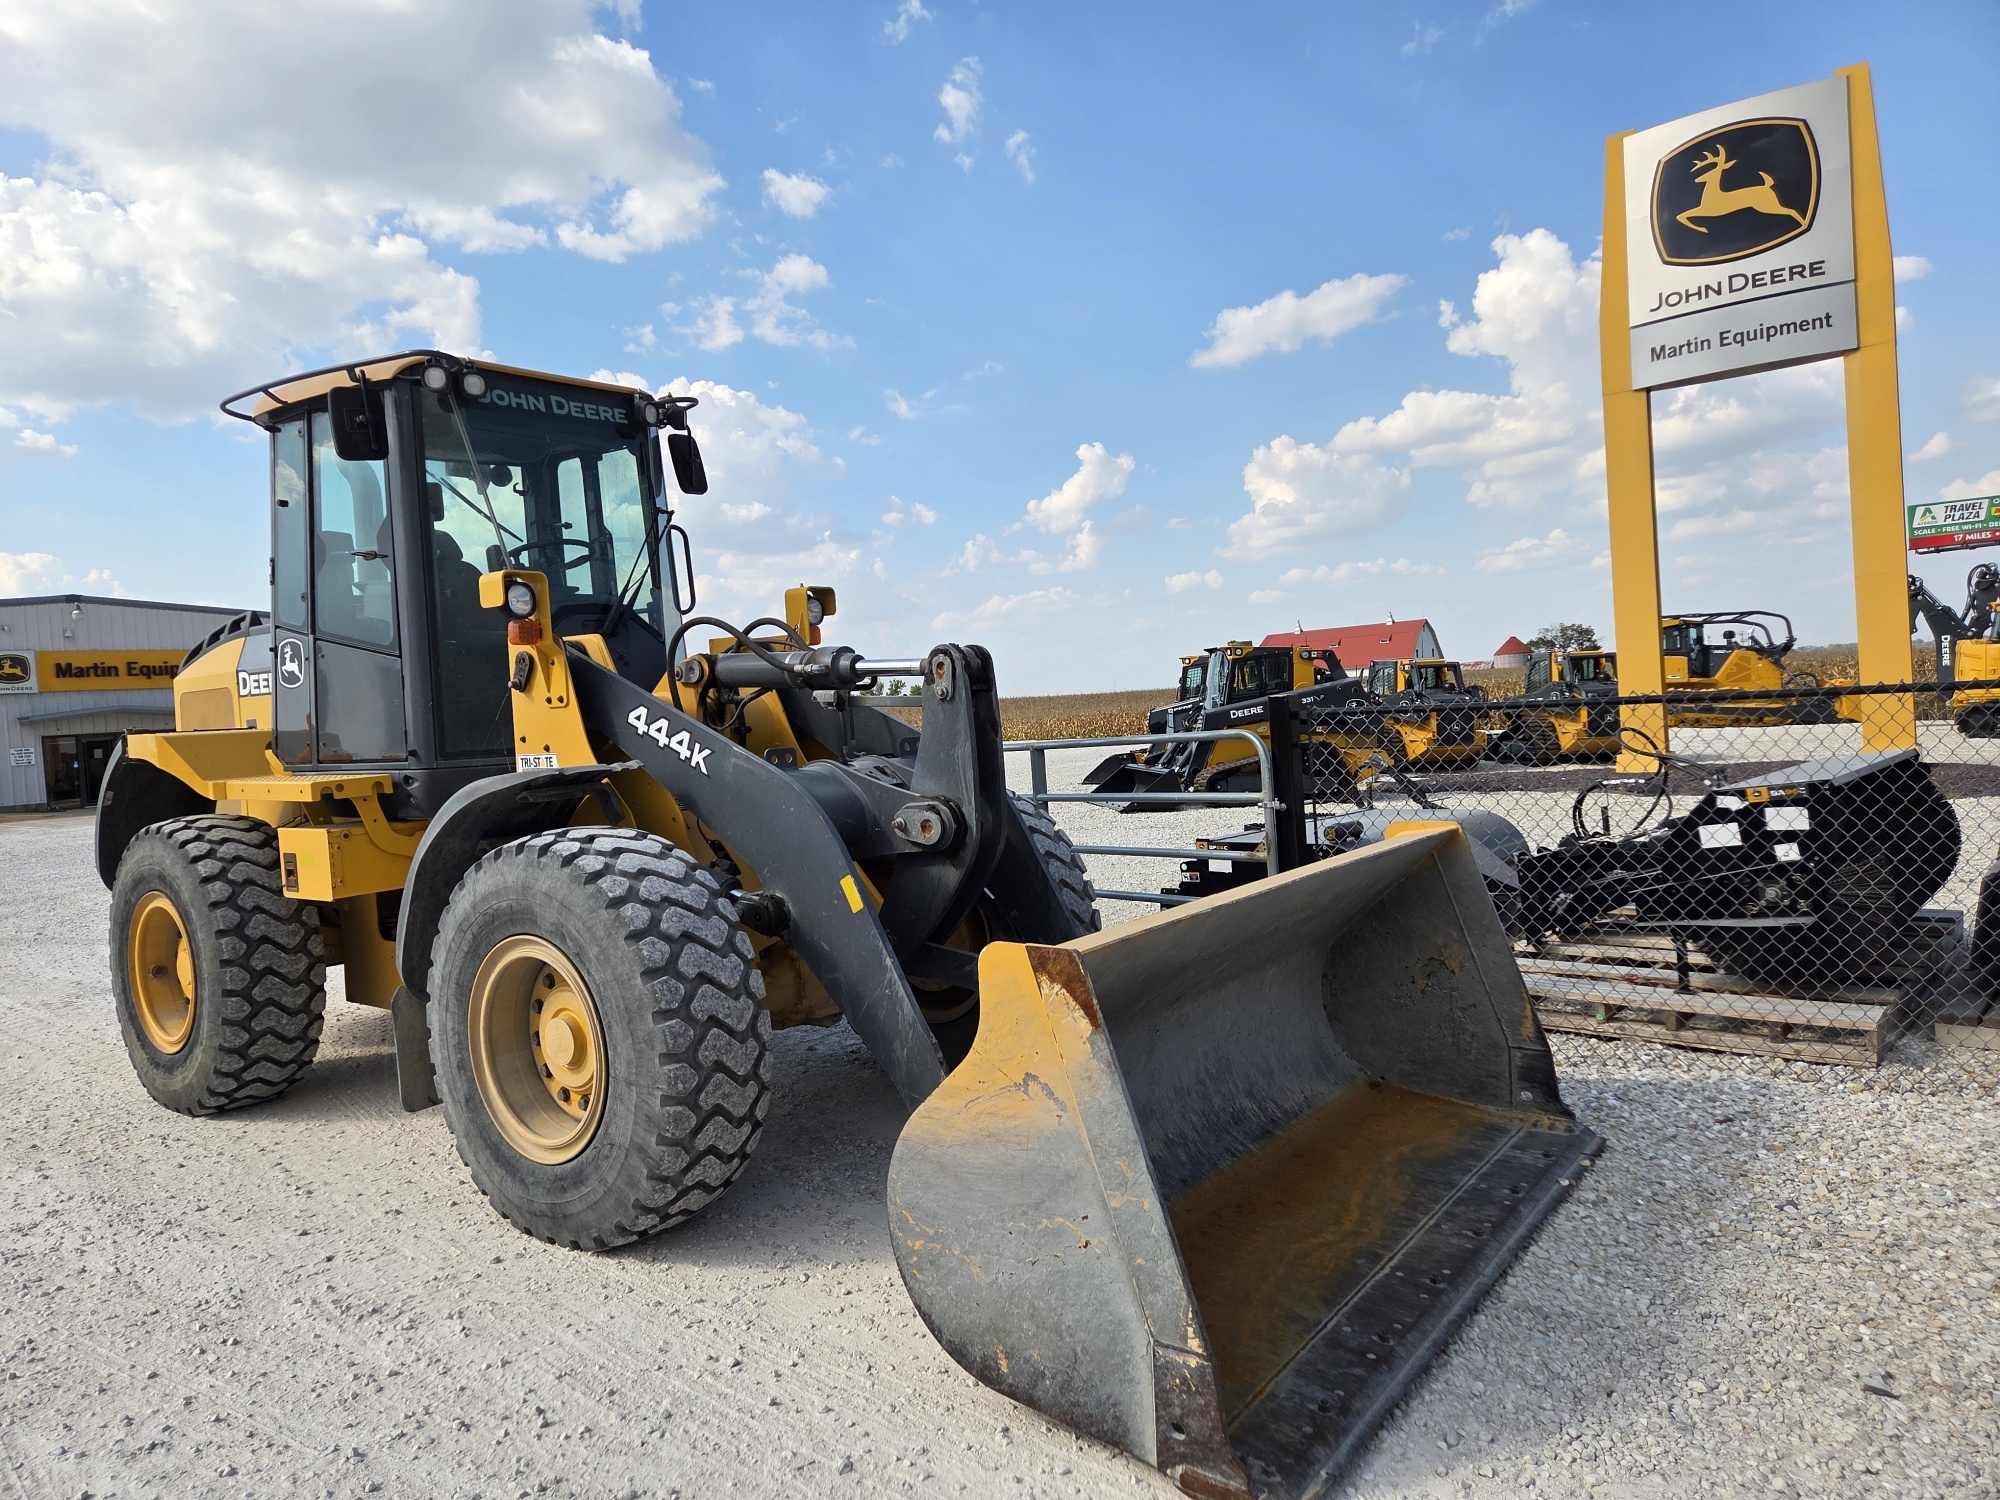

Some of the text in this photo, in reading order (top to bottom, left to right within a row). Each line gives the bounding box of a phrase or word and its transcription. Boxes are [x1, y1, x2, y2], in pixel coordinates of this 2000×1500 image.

[1650, 260, 1826, 312] JOHN DEERE
[1650, 312, 1833, 363] Martin Equipment
[478, 389, 629, 424] JOHN DEERE
[1943, 511, 1980, 522] PLAZA
[1944, 501, 1984, 514] TRAVEL
[1913, 528, 1936, 536] SCALE
[1953, 531, 1992, 542] 17 MILES
[1941, 635, 1950, 667] DEERE
[55, 661, 119, 679] Martin
[238, 671, 272, 696] DEE
[1229, 705, 1264, 719] DEERE
[627, 705, 712, 776] 444K
